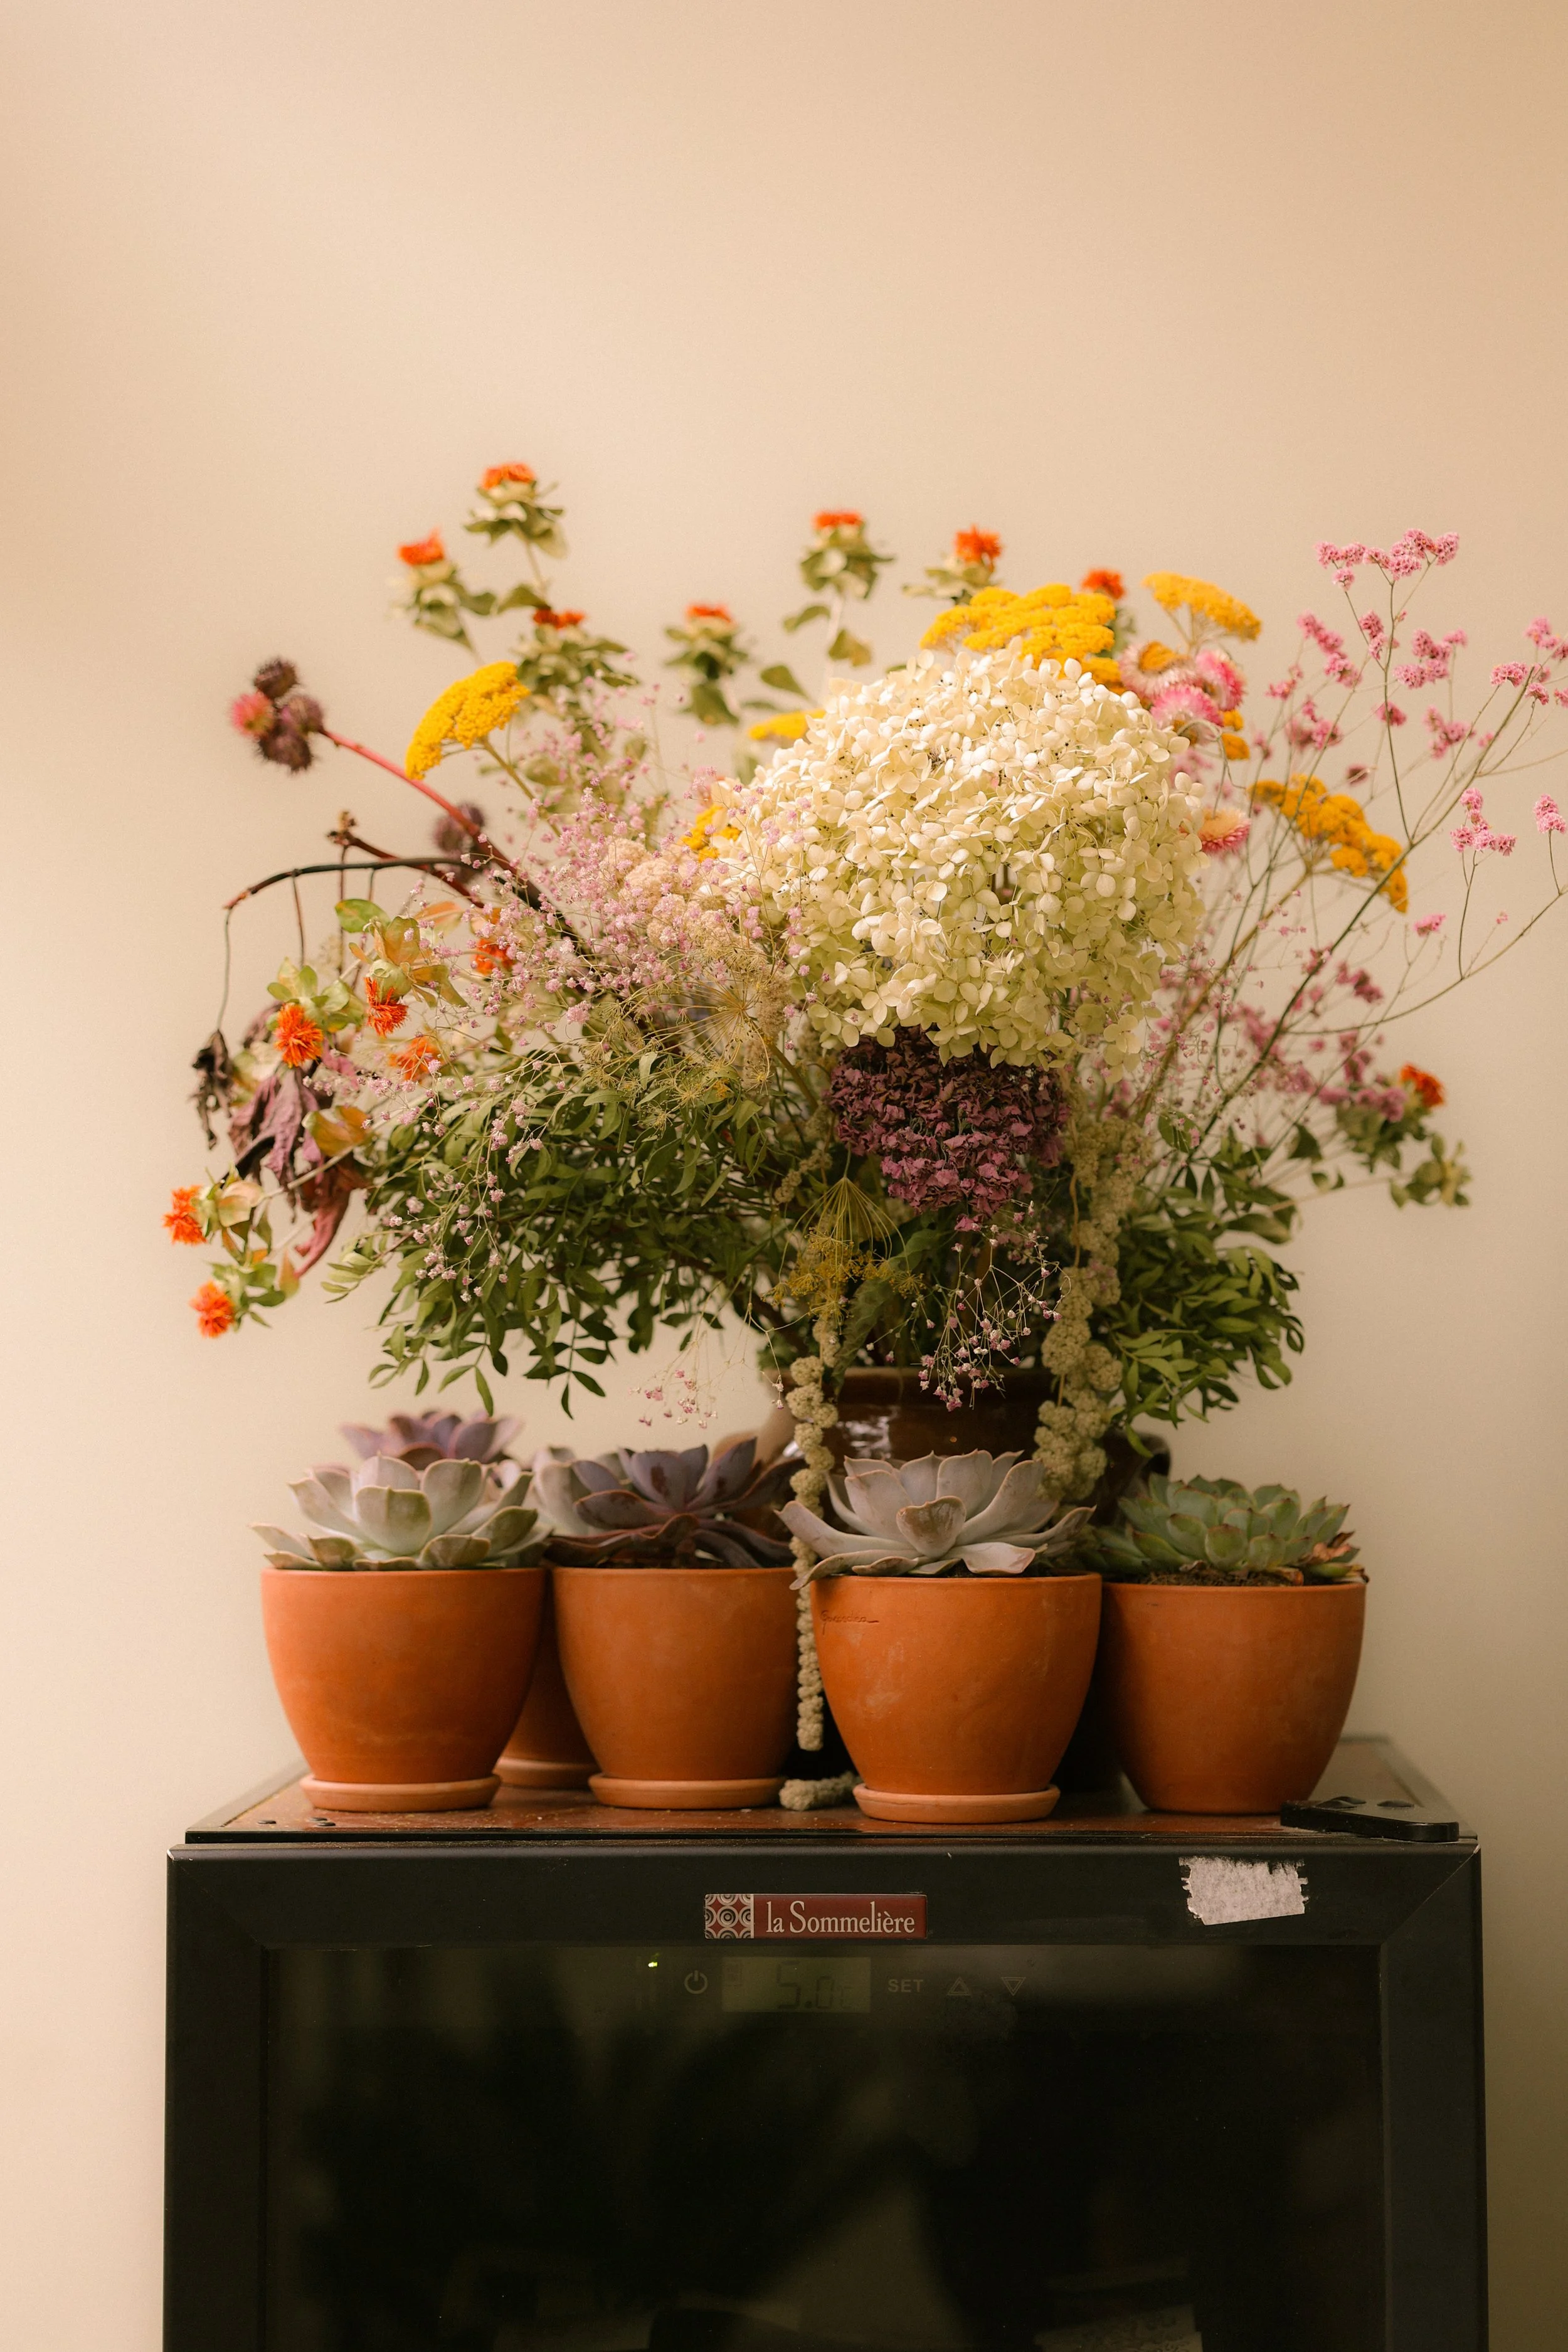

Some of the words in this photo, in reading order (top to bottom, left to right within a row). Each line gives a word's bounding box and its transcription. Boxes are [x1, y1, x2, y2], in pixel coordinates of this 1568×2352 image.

[766, 1900, 785, 1933] la
[789, 1900, 915, 1934] Sommelière
[887, 1979, 924, 1993] SET
